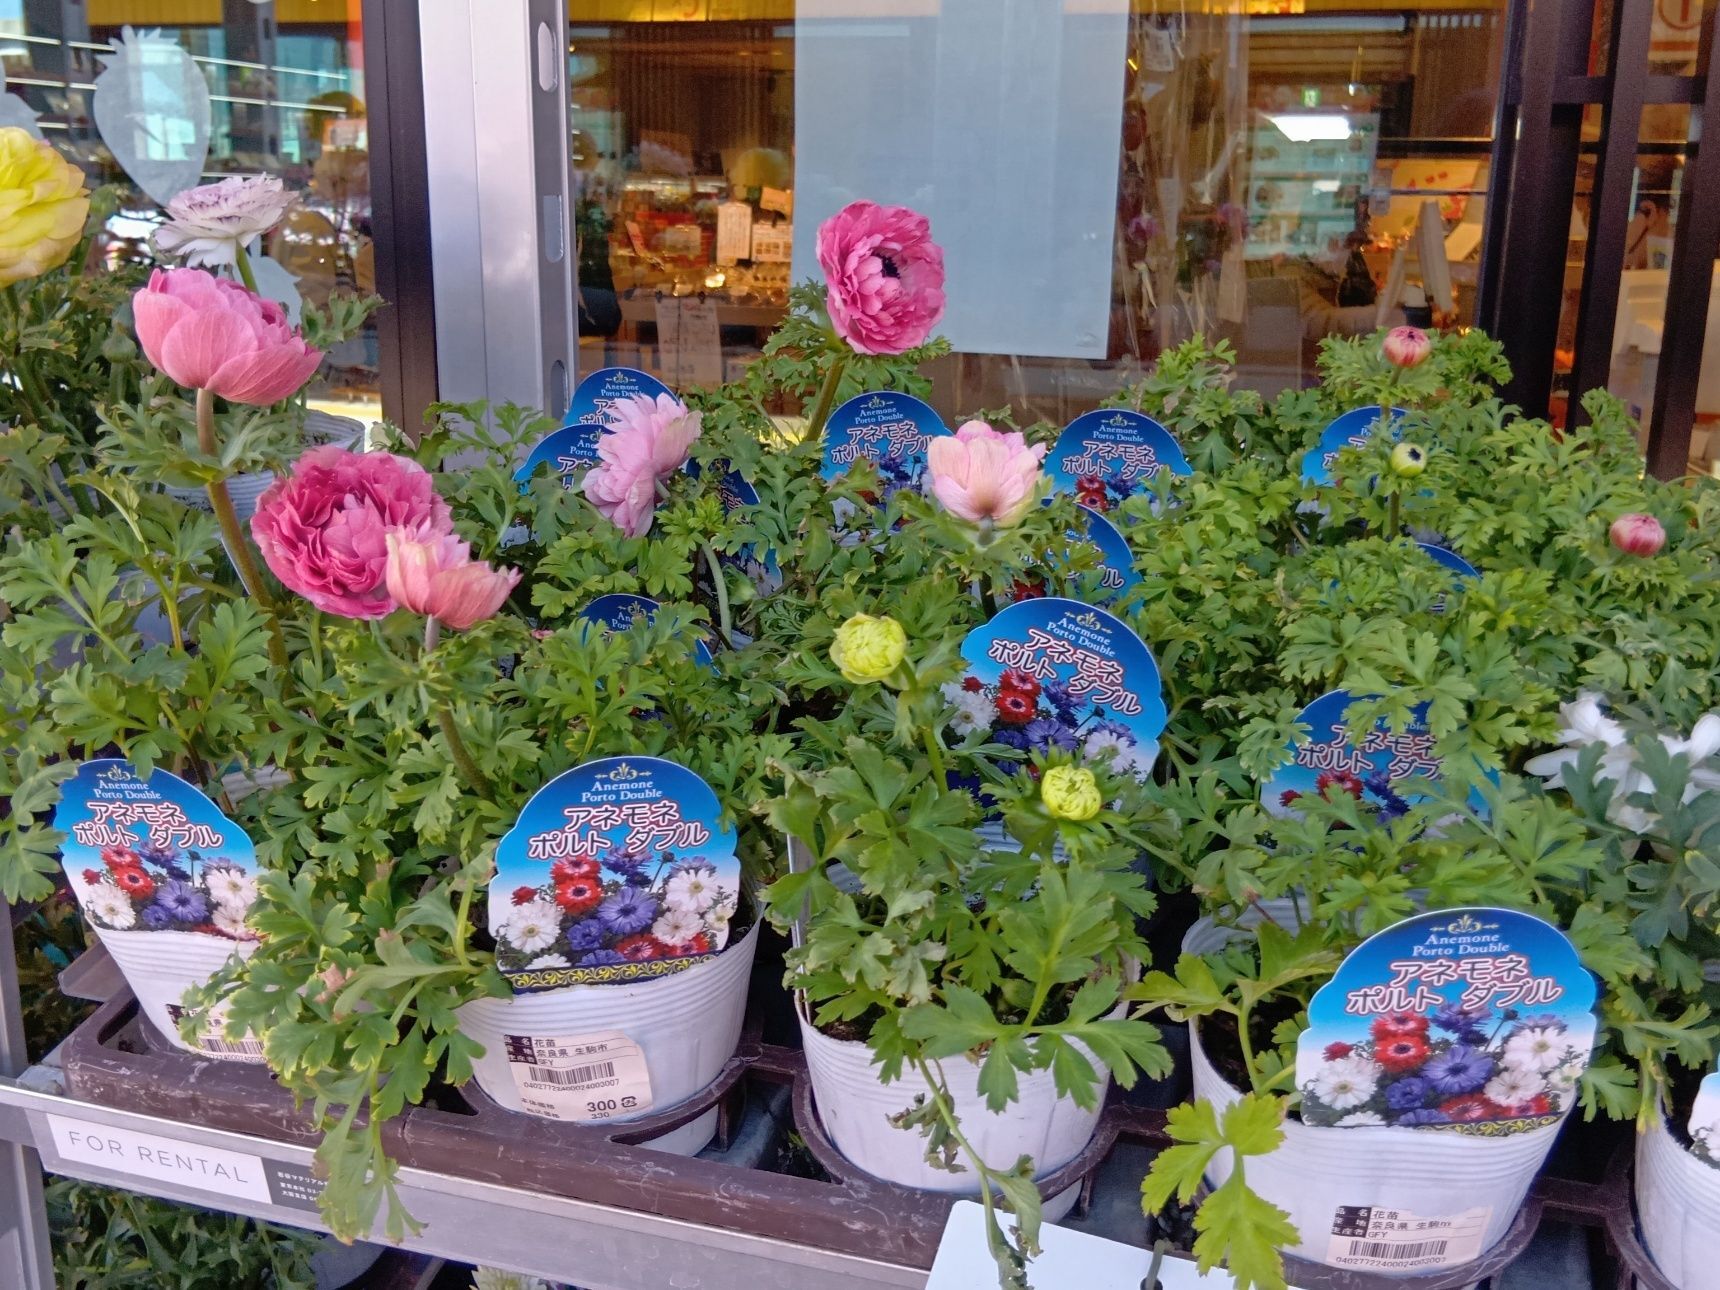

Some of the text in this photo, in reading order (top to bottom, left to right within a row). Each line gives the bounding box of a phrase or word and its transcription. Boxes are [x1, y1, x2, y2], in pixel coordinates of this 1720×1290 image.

[601, 389, 620, 397] Porto
[605, 383, 639, 391] Anemone
[855, 412, 904, 425] Porto Double
[860, 407, 897, 417] Anemone
[847, 420, 918, 445] アネモネ
[1093, 431, 1144, 442] Porto Double
[1098, 424, 1138, 435] Anemone
[570, 446, 593, 457] Porto
[831, 443, 880, 464] ポルト
[1082, 440, 1155, 463] アネモネ
[1062, 456, 1112, 477] ポルト
[1057, 617, 1111, 646] Anemone
[1047, 621, 1116, 658] Porto Double
[1024, 628, 1124, 684] アネモネ
[988, 639, 1142, 715] ポルト ダブル
[1297, 743, 1374, 774] ポルト
[99, 780, 150, 790] Anemone
[591, 780, 654, 792] Anemone
[93, 789, 162, 800] Porto Double
[581, 789, 662, 803] Porto Double
[87, 802, 187, 826] アネモネ
[564, 800, 679, 832] アネモネ
[73, 823, 223, 849] ポルト ダブル
[528, 822, 709, 859] ポルト ダブル
[1425, 933, 1500, 945] Anemone
[1412, 942, 1510, 957] Porto Double
[1390, 954, 1528, 987] アネモネ
[1346, 978, 1563, 1014] ポルト ダブル
[534, 1039, 556, 1048] 花苗
[536, 1049, 568, 1058] 奈良県
[575, 1044, 608, 1055] 生駒市
[587, 1099, 617, 1112] 300
[68, 1130, 248, 1184] FOR RENTAL
[1371, 1221, 1409, 1230] 奈良県
